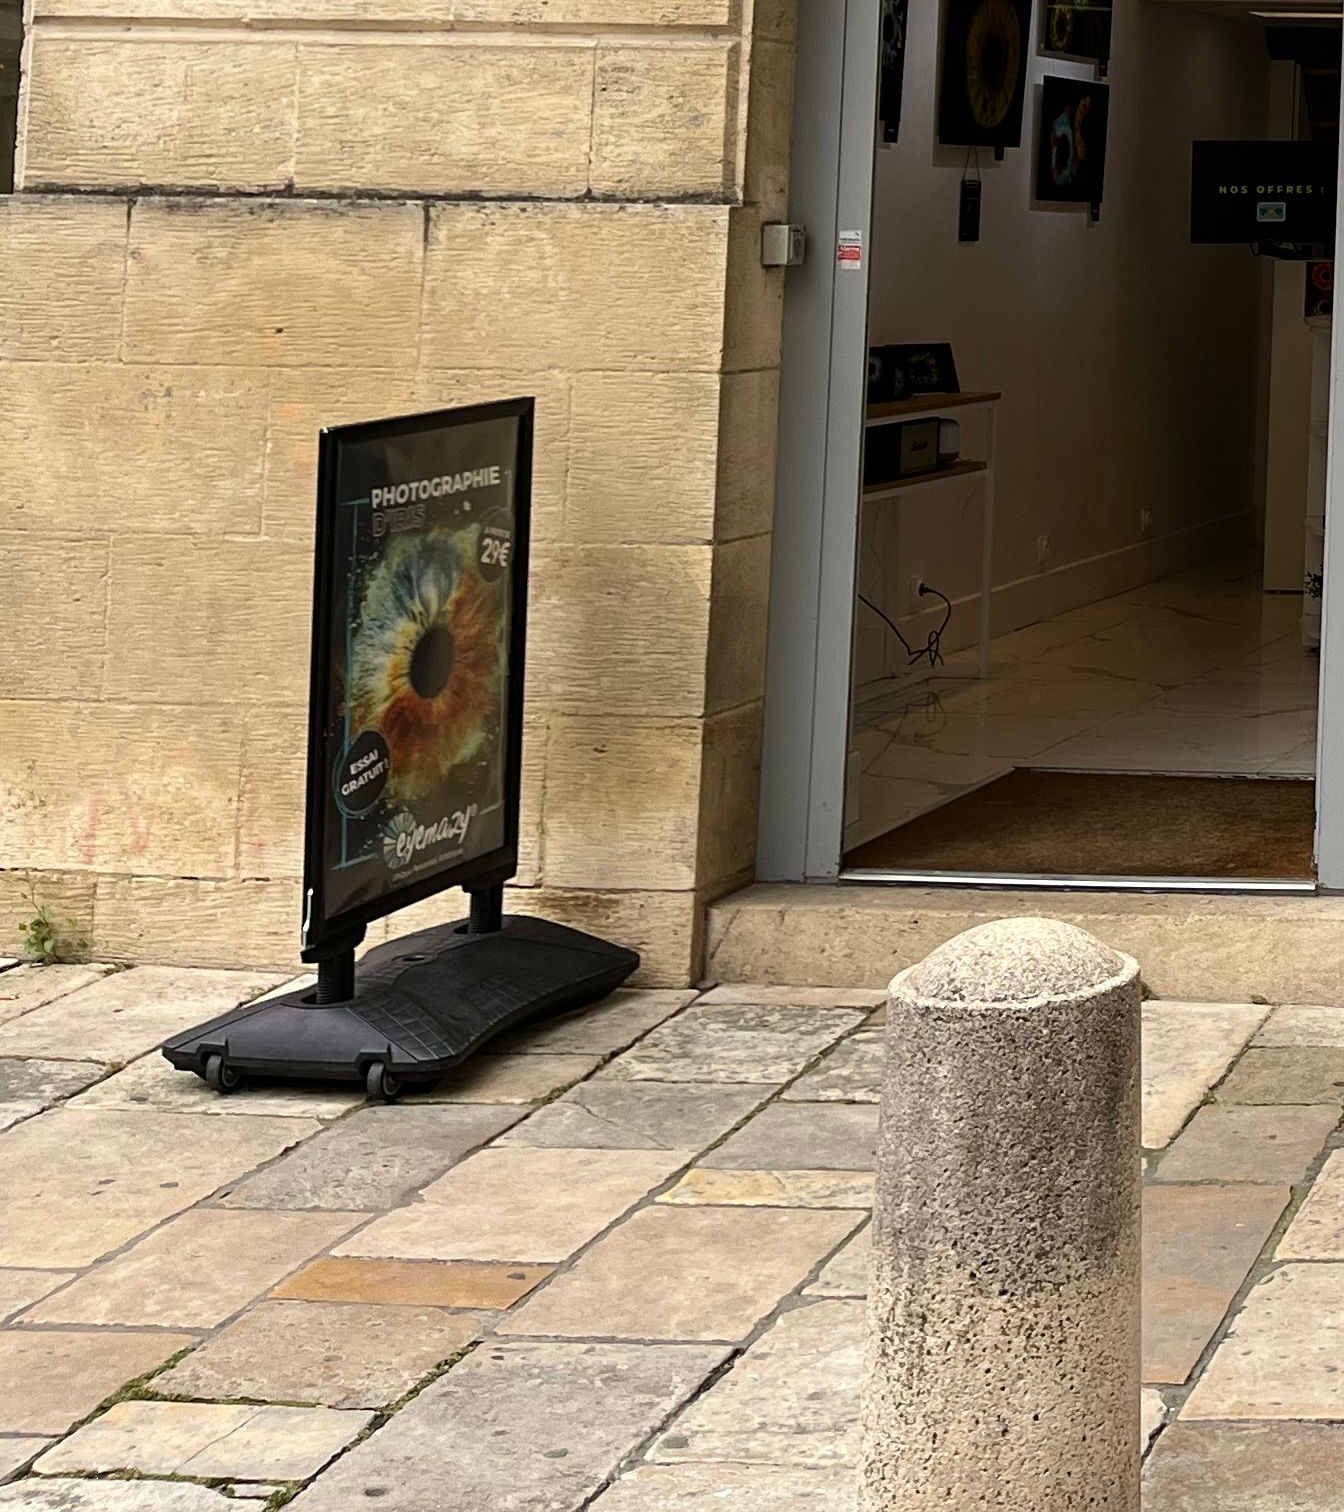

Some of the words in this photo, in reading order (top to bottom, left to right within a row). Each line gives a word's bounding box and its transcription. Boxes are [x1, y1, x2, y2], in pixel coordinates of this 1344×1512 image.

[1218, 185, 1248, 194] NOS
[1256, 185, 1313, 194] OFFRES
[371, 465, 501, 509] PHOTOGRAPHIE
[480, 536, 512, 568] 29€
[349, 748, 380, 776] ESSAI
